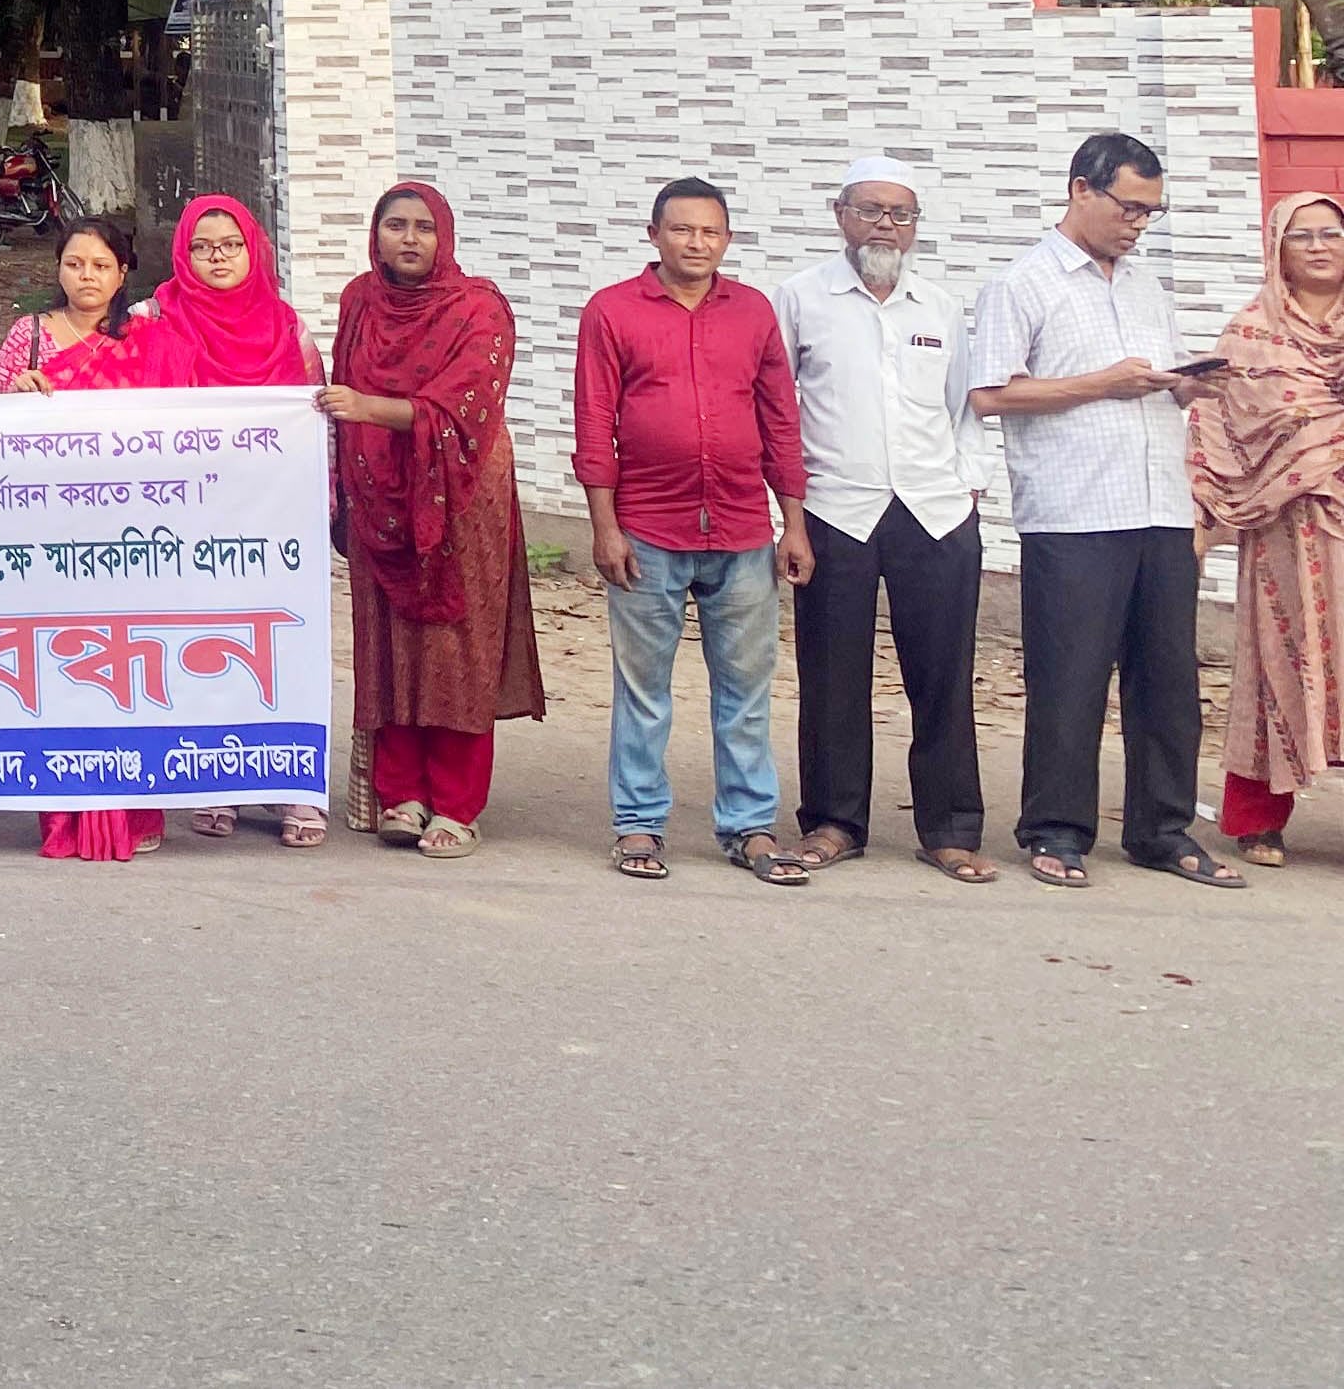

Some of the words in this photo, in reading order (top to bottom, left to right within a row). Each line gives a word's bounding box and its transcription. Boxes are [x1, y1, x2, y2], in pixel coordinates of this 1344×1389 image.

[111, 429, 164, 457] ১০ম
[173, 426, 223, 455] গ্রেড
[231, 426, 283, 454] এবং
[56, 480, 131, 509] করতে
[39, 525, 184, 581] স্মারকলিপি
[192, 533, 269, 581] প্রদান
[278, 537, 300, 572] ও
[162, 733, 318, 781] মৌলভীবাজার
